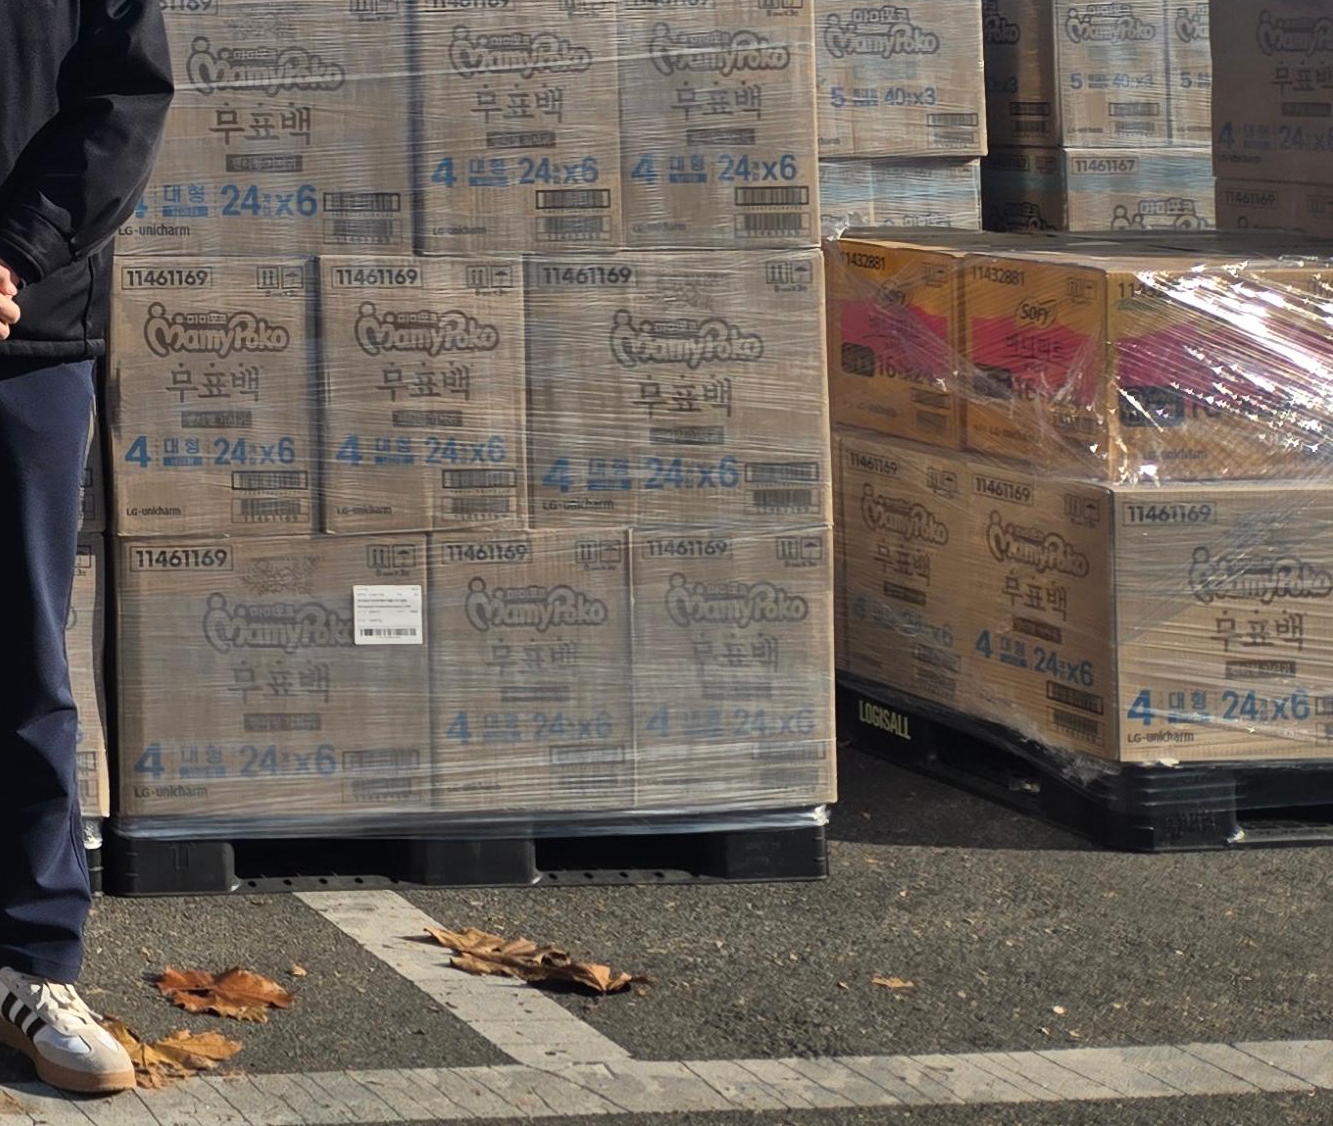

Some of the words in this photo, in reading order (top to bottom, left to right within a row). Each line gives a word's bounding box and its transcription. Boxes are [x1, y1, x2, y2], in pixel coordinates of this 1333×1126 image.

[824, 12, 939, 59] MamyPoko
[831, 86, 846, 108] 5
[1070, 73, 1082, 89] 5
[470, 84, 565, 123] 무표백
[671, 82, 764, 121] 무표백
[209, 102, 312, 146] 무표백
[433, 157, 457, 188] 4
[632, 153, 655, 182] 4
[1075, 159, 1135, 173] 11461167
[117, 224, 191, 236] LG-unicharm
[127, 269, 209, 286] 11461169
[335, 268, 418, 285] 11461169
[543, 266, 632, 285] 11461169
[144, 302, 290, 359] MamyPoko
[354, 301, 500, 357] MamyPoko
[609, 309, 764, 370] MamyPoko
[165, 363, 260, 403] 무표백
[376, 362, 471, 402] 무표백
[633, 376, 732, 418] 무표백
[124, 435, 151, 468] 4
[335, 434, 363, 467] 4
[849, 453, 899, 476] 11461169
[541, 458, 573, 493] 4
[975, 478, 1032, 502] 11461169
[126, 506, 182, 516] LG-unicharm
[1128, 503, 1212, 523] 11461169
[135, 548, 228, 568] 11461169
[446, 544, 528, 561] 11461169
[646, 540, 728, 557] 11461169
[987, 510, 1090, 578] MamyPoko
[465, 577, 608, 633] MamyPoko
[1001, 570, 1069, 621] 무표백
[1210, 611, 1305, 651] 무표백
[227, 660, 331, 704] 무표백
[1168, 691, 1208, 710] 대형
[859, 699, 912, 741] LOGISALL
[1127, 730, 1195, 744] LG-unicharm
[134, 743, 165, 778] 4
[134, 786, 208, 799] LG-unicharm
